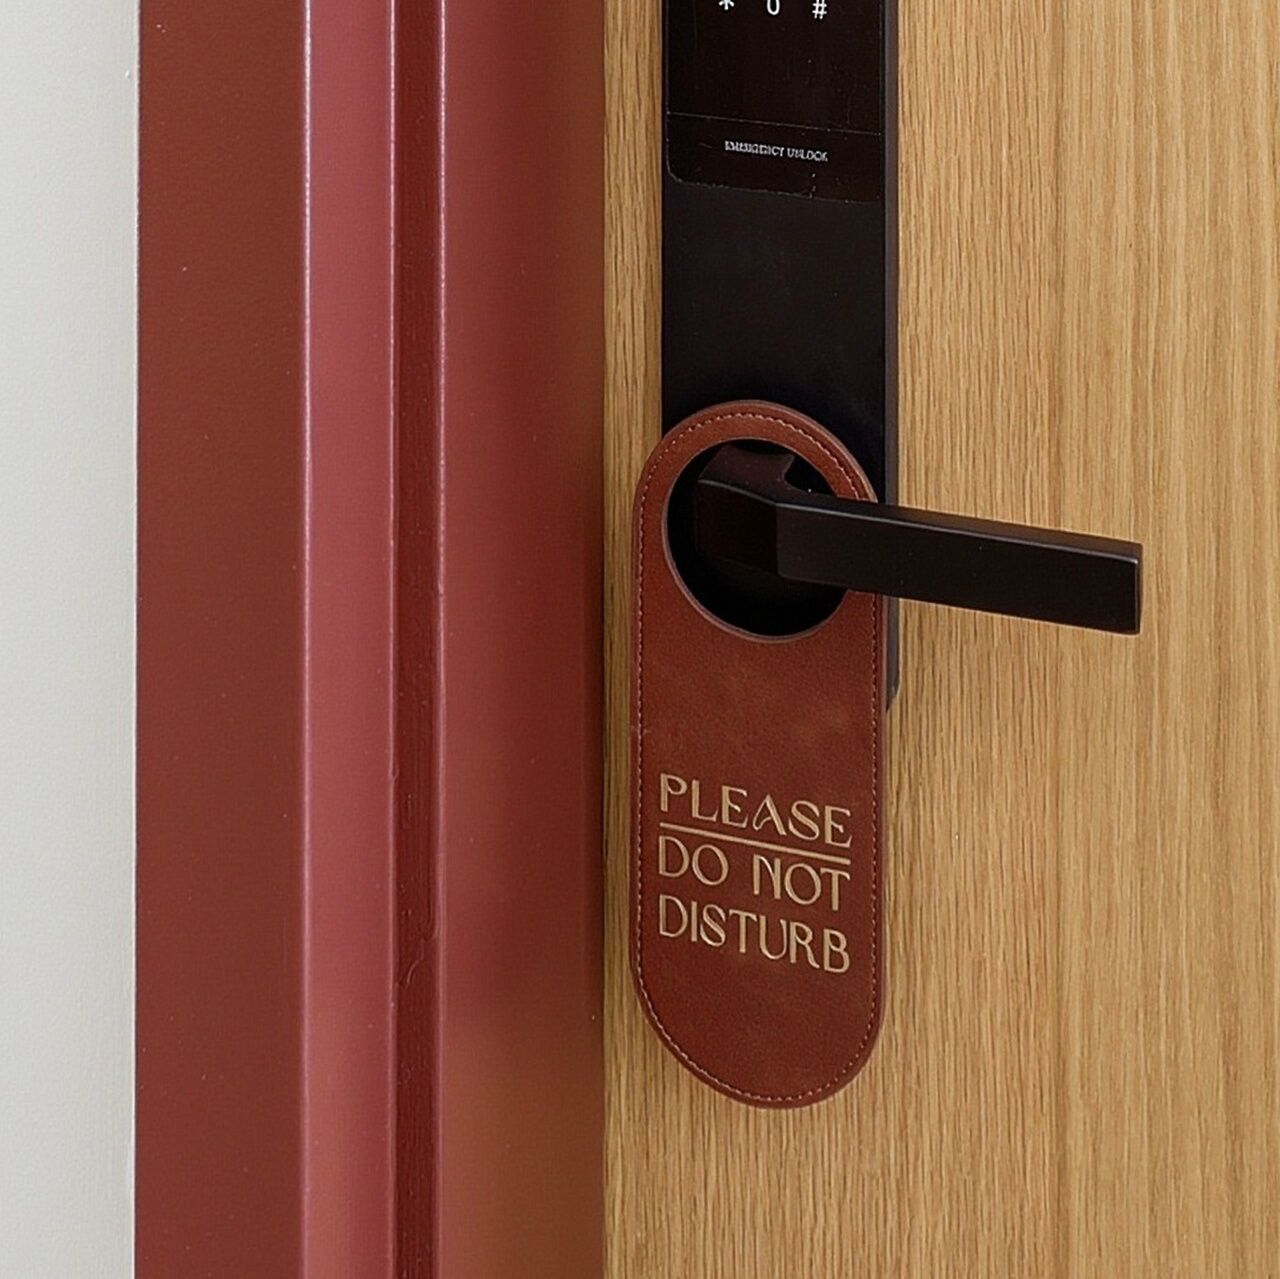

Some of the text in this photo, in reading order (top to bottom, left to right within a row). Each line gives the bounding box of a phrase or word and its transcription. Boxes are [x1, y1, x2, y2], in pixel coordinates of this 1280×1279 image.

[660, 772, 852, 848] PLEASE
[658, 835, 851, 911] DO NOT
[659, 893, 851, 973] DISTURB
